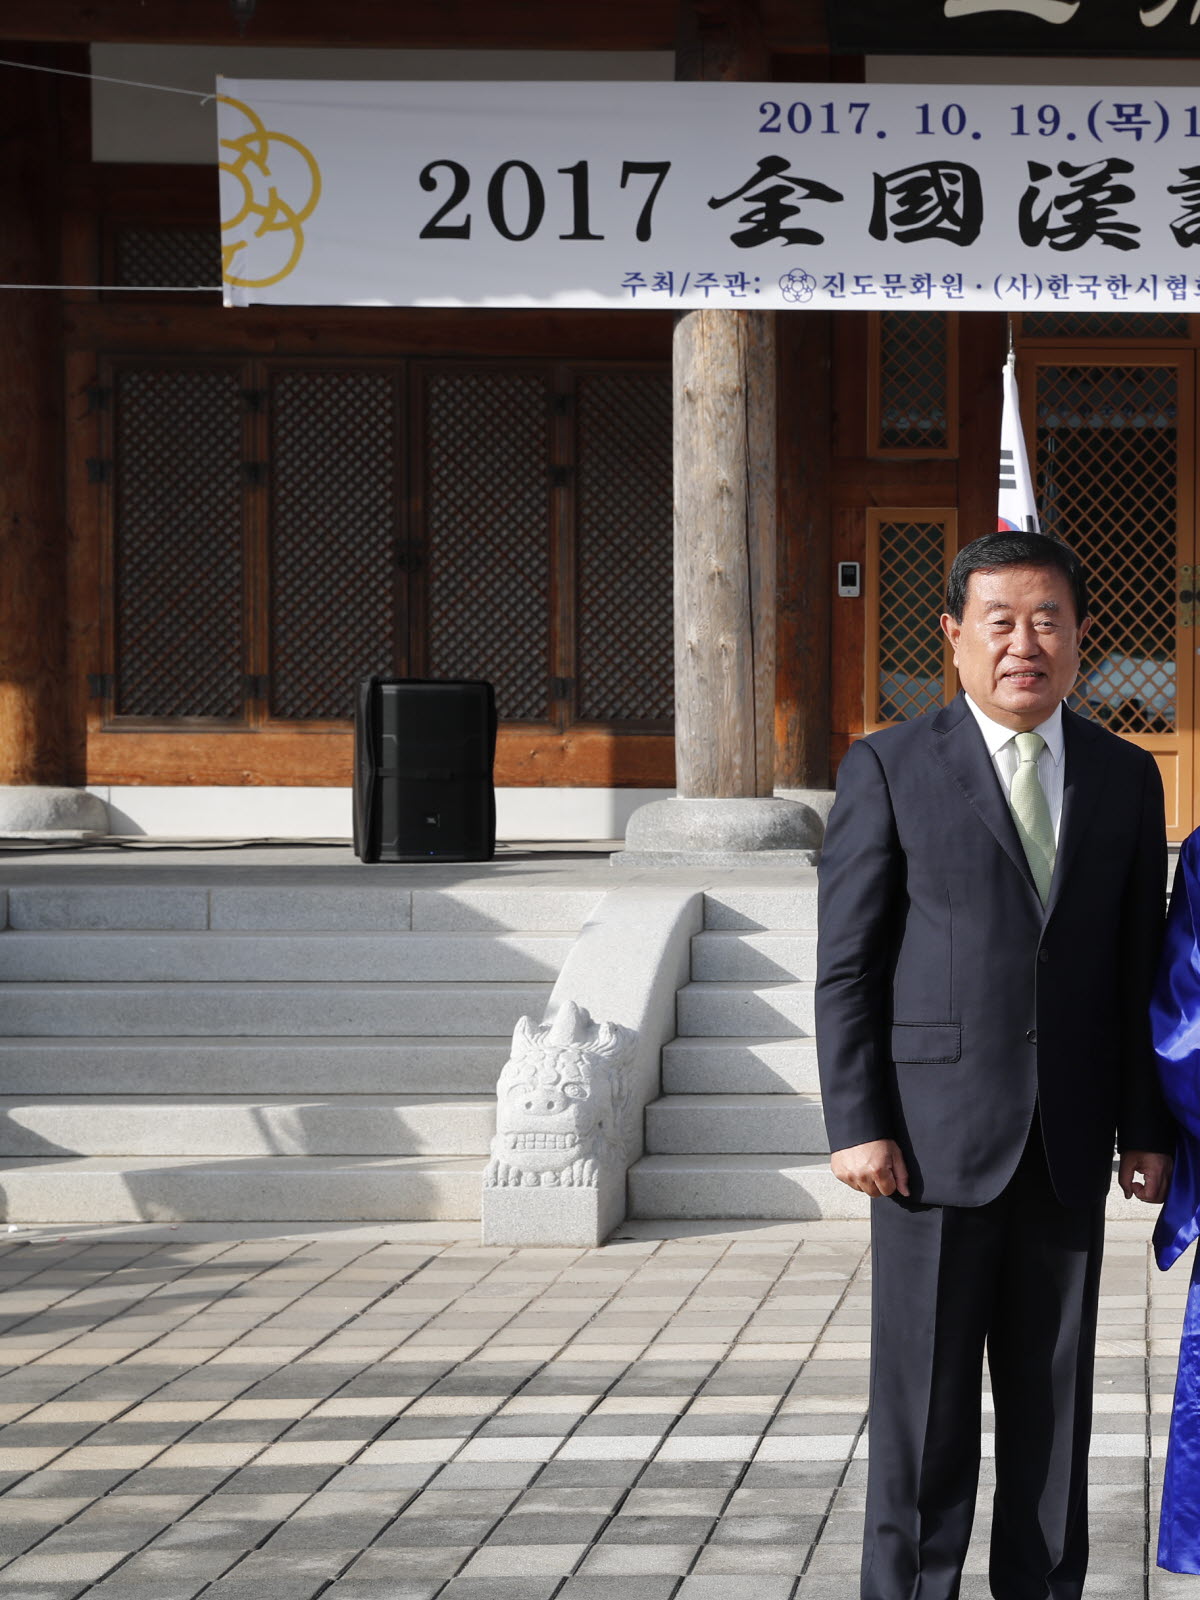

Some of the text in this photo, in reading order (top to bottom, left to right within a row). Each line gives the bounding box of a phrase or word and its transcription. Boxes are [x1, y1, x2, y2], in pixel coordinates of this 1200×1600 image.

[759, 103, 888, 140] 2017.
[914, 104, 983, 141] 10.
[418, 159, 672, 242] 2017
[620, 271, 763, 298] 주최/주관:
